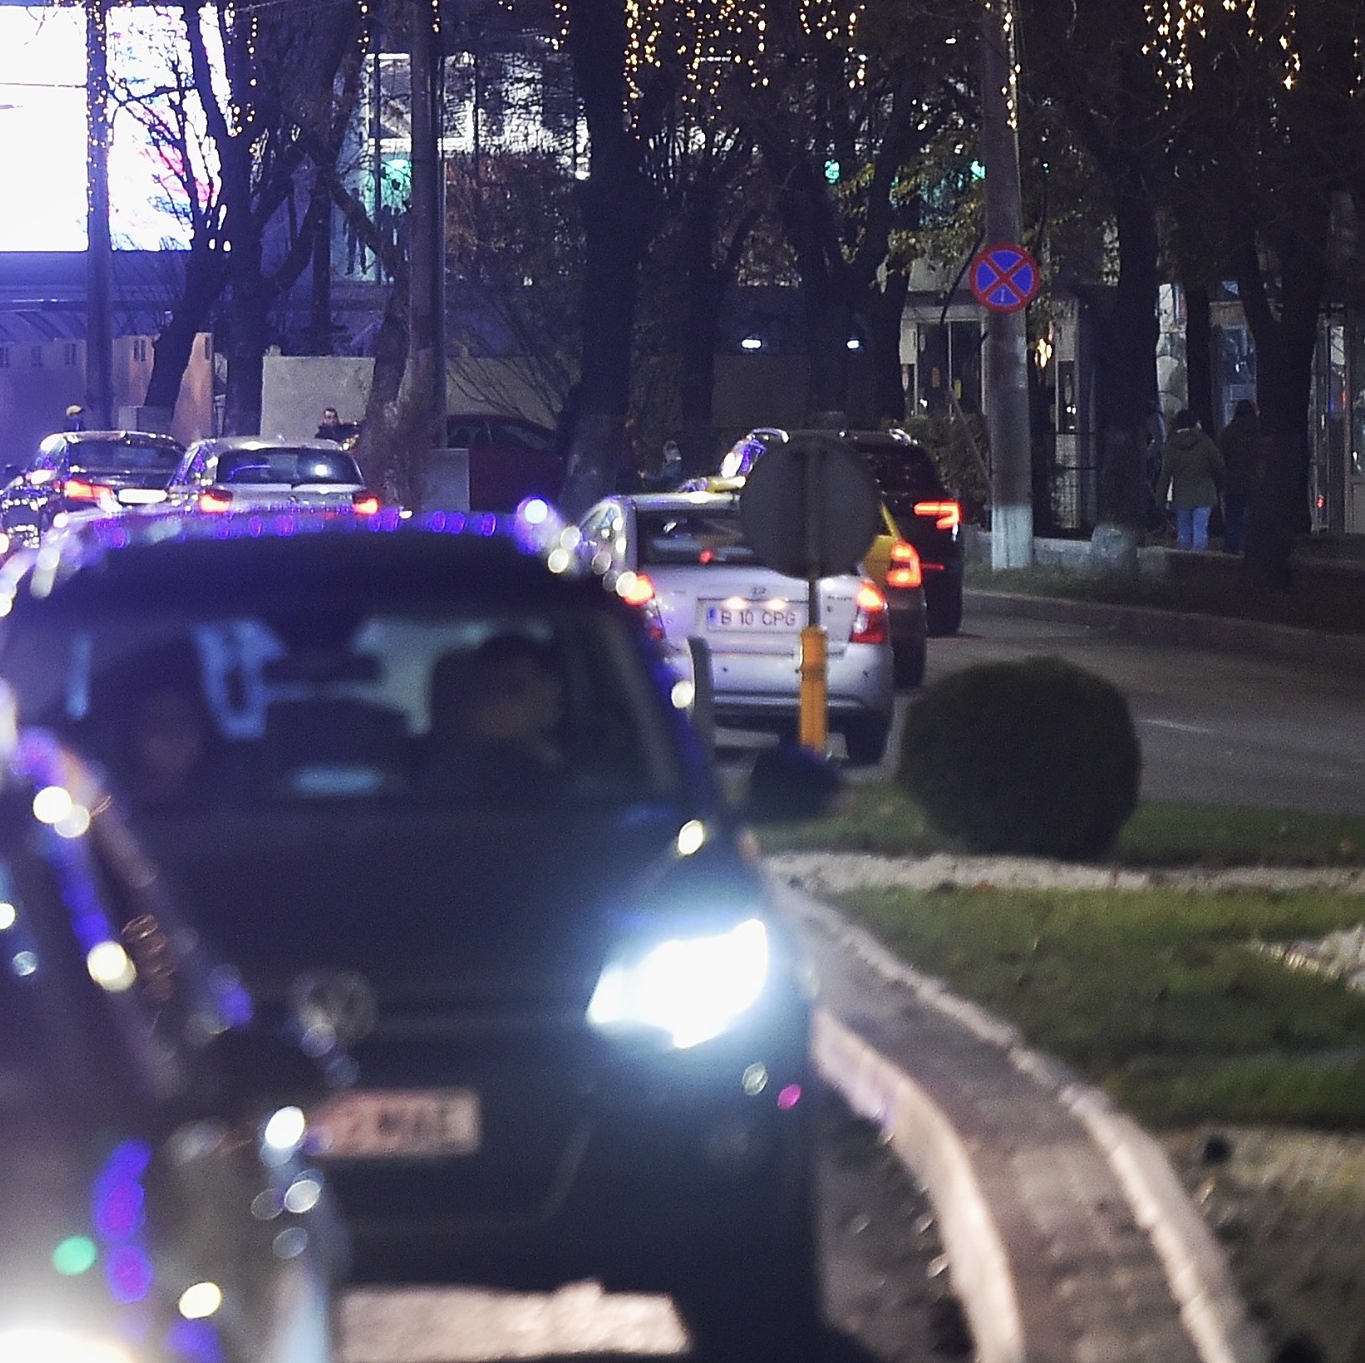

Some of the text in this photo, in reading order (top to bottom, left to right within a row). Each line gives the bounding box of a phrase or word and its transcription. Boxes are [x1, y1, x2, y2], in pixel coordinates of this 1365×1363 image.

[721, 611, 796, 626] B 10 CPG
